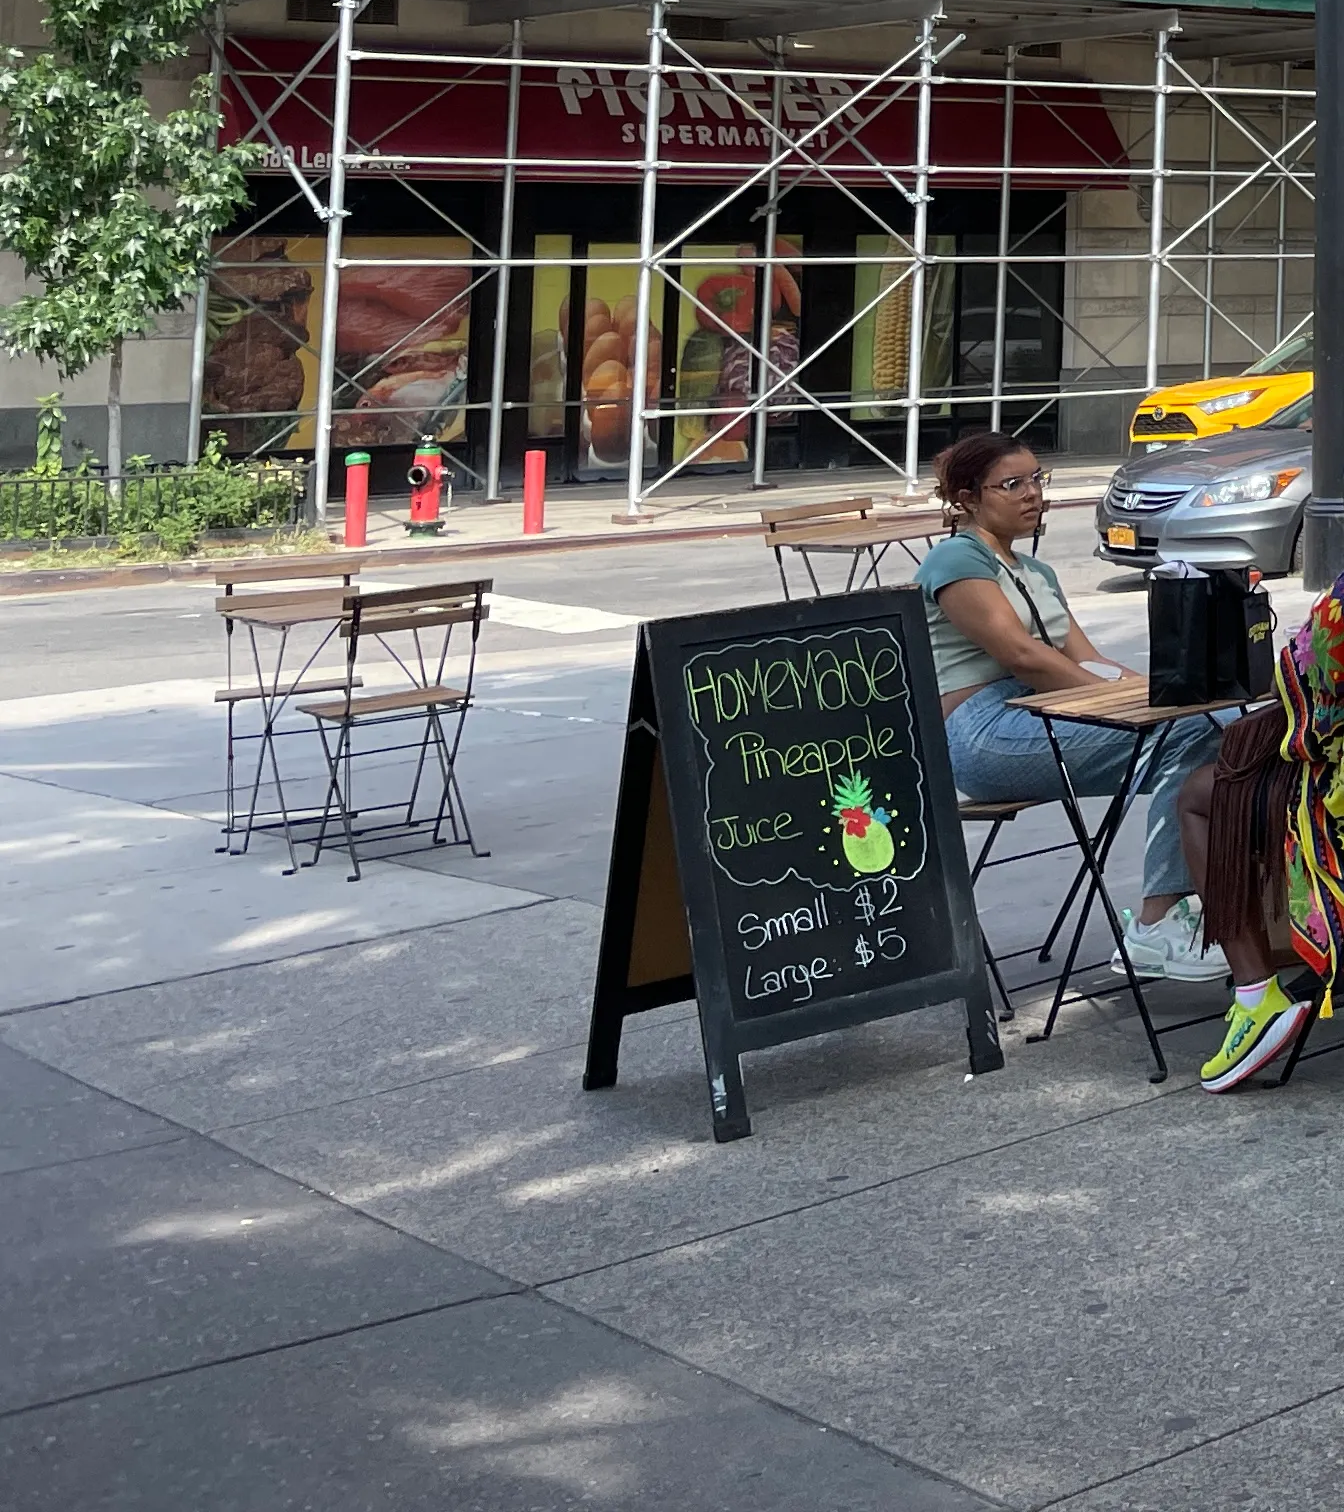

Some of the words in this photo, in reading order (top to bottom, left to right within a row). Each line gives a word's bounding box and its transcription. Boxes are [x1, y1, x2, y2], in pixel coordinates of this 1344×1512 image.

[556, 67, 865, 124] PIONEER
[726, 714, 903, 798] Pineapple
[712, 810, 804, 851] Juice
[854, 877, 903, 927] $2
[854, 926, 907, 969] $5
